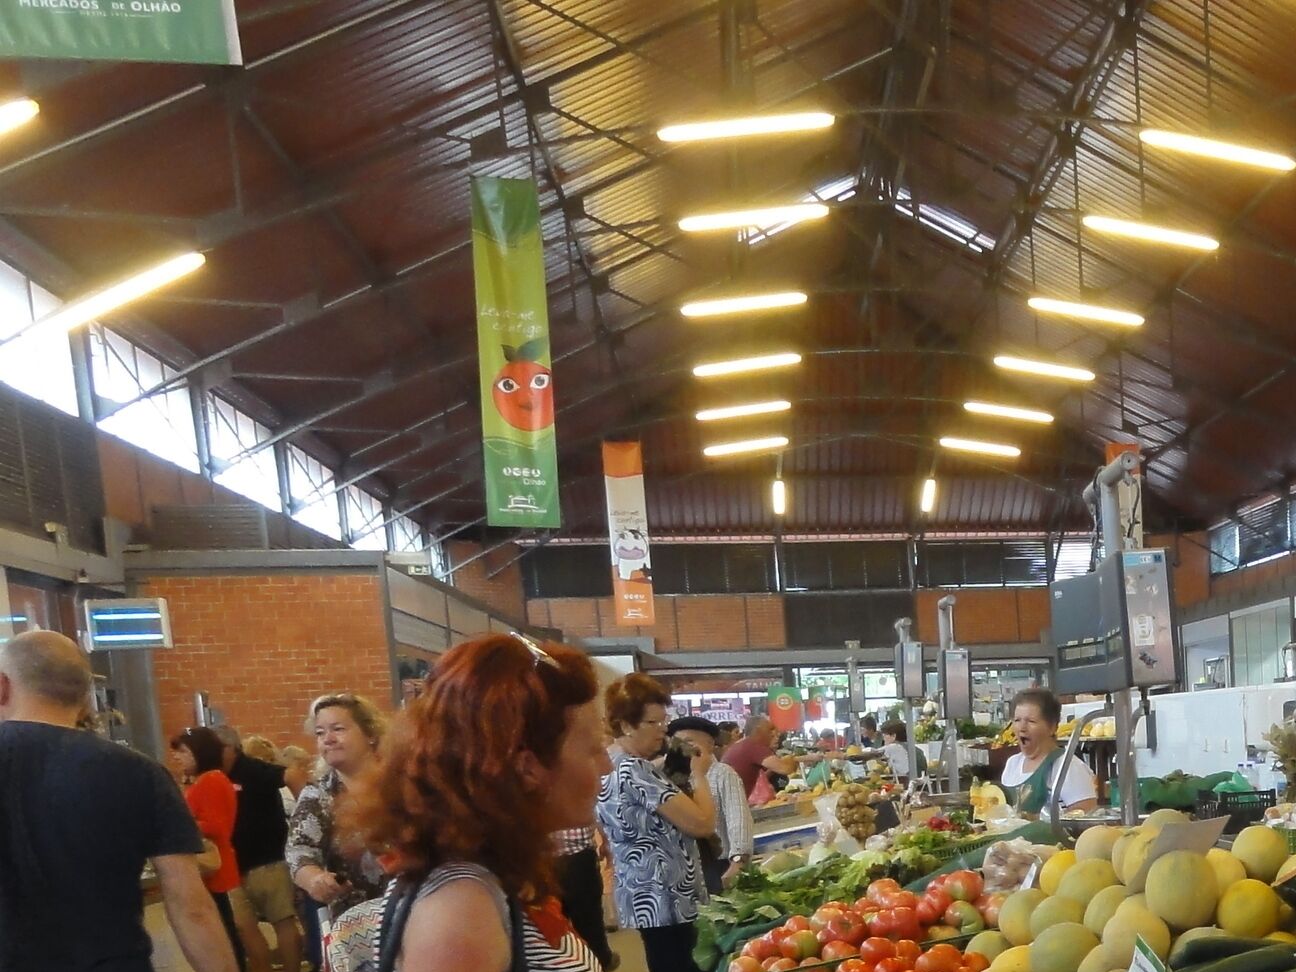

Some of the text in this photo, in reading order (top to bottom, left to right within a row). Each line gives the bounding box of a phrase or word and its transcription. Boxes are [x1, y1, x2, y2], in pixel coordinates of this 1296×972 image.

[20, 0, 182, 13] MERCADOS DE OLHÃO
